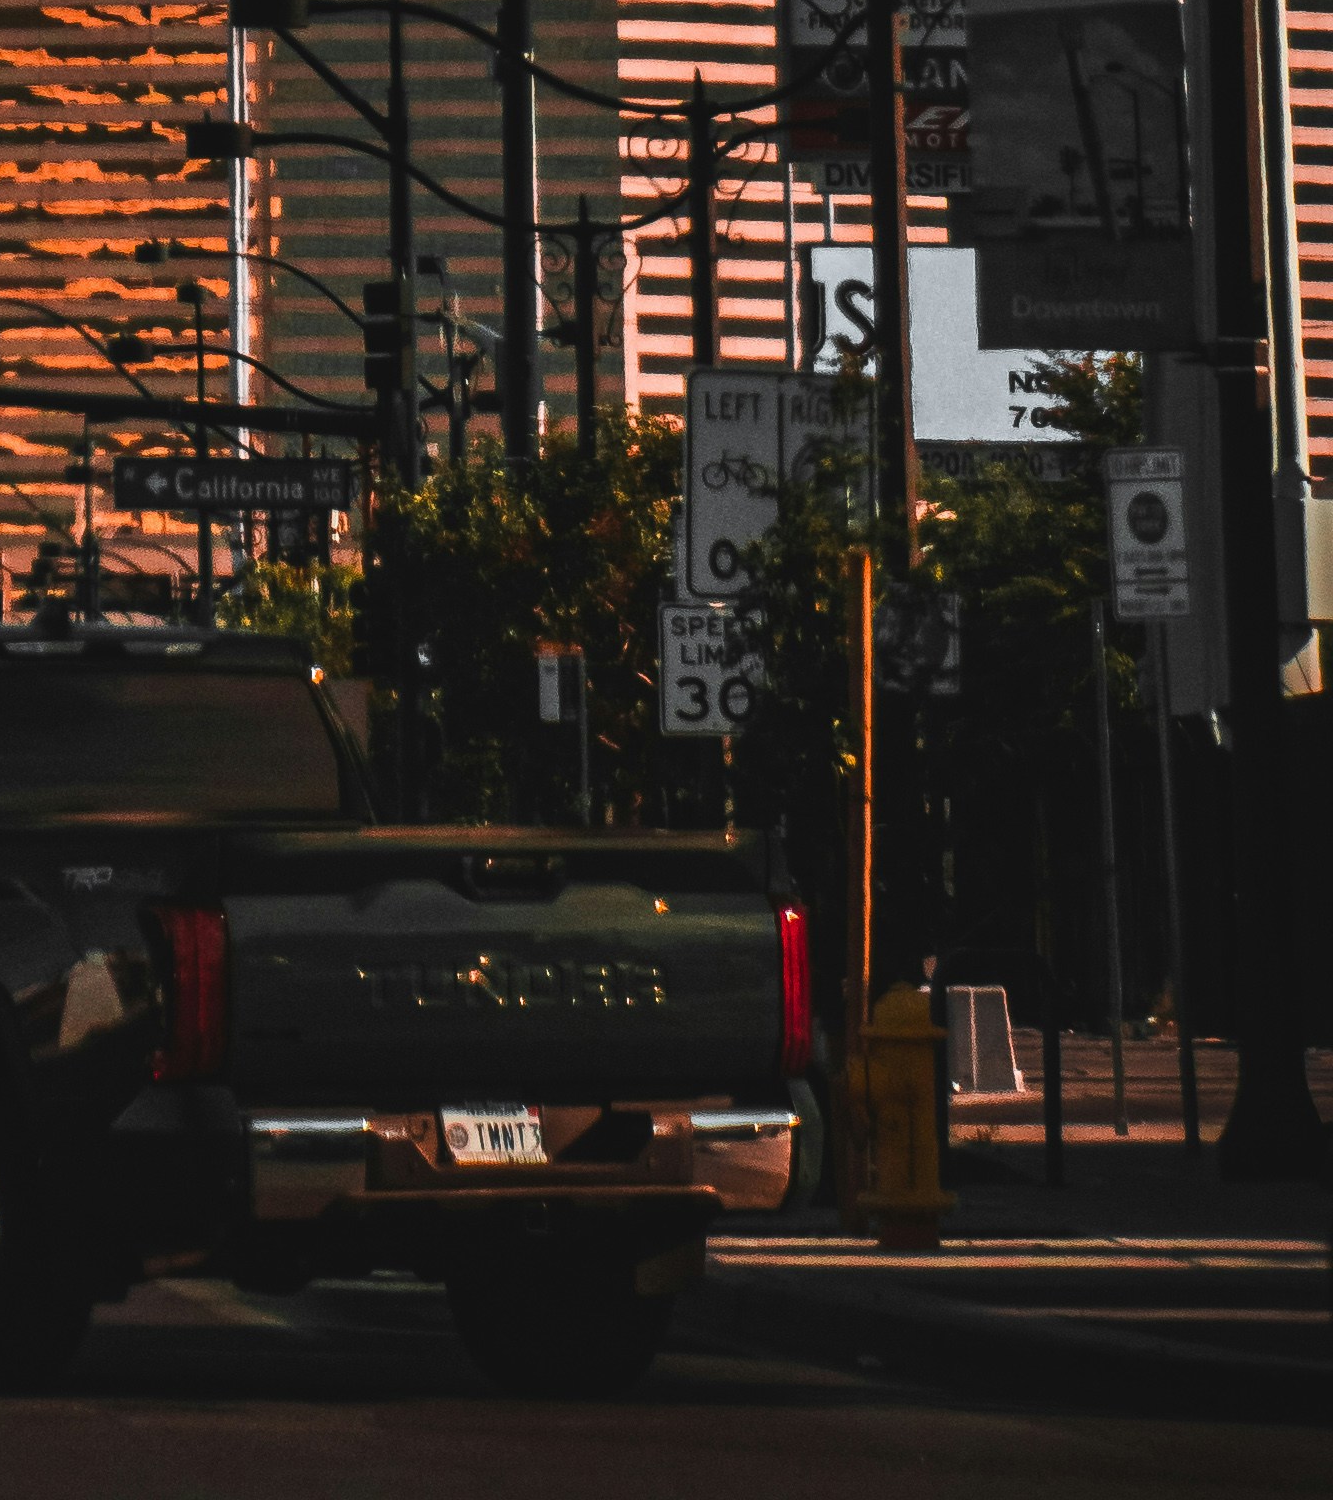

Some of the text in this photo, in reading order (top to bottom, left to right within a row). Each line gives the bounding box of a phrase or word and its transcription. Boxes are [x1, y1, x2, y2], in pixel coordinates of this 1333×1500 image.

[704, 392, 761, 423] LEFT
[174, 466, 304, 500] California
[312, 467, 341, 483] AVE
[676, 675, 756, 722] 30
[354, 959, 668, 1008] TUNDRA
